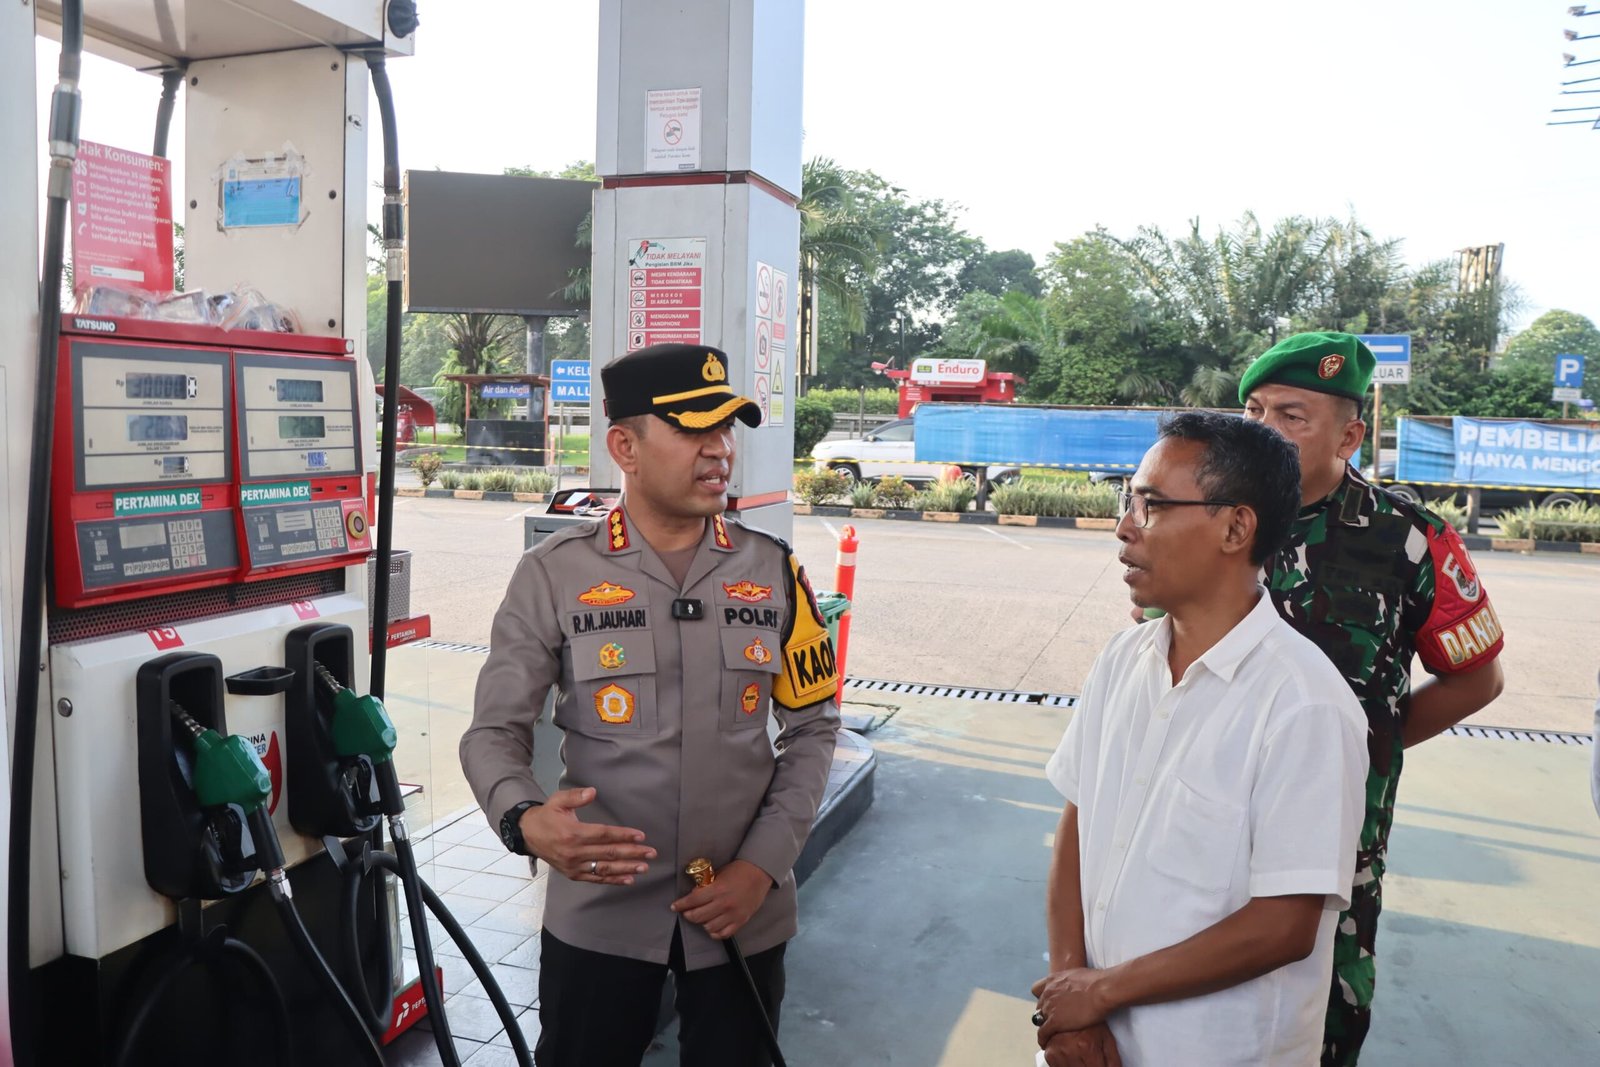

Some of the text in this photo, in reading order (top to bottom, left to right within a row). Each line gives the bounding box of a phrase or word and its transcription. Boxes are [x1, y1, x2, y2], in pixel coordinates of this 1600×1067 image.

[79, 141, 164, 172] Hak Konsumen:
[74, 158, 87, 176] 3S
[667, 252, 702, 260] MELAYANI
[75, 319, 116, 332] TATSUNO
[938, 363, 980, 375] Enduro
[1560, 359, 1580, 382] P
[483, 385, 494, 394] Air
[495, 385, 508, 394] dan
[1460, 451, 1527, 470] HANYA
[115, 492, 200, 511] PERTAMINA DEX
[241, 486, 310, 502] PERTAMINA DEX
[125, 565, 133, 573] P1
[134, 564, 142, 572] P2
[143, 562, 152, 570] P3
[724, 607, 778, 629] POLRI
[390, 628, 416, 641] PERTAMINA
